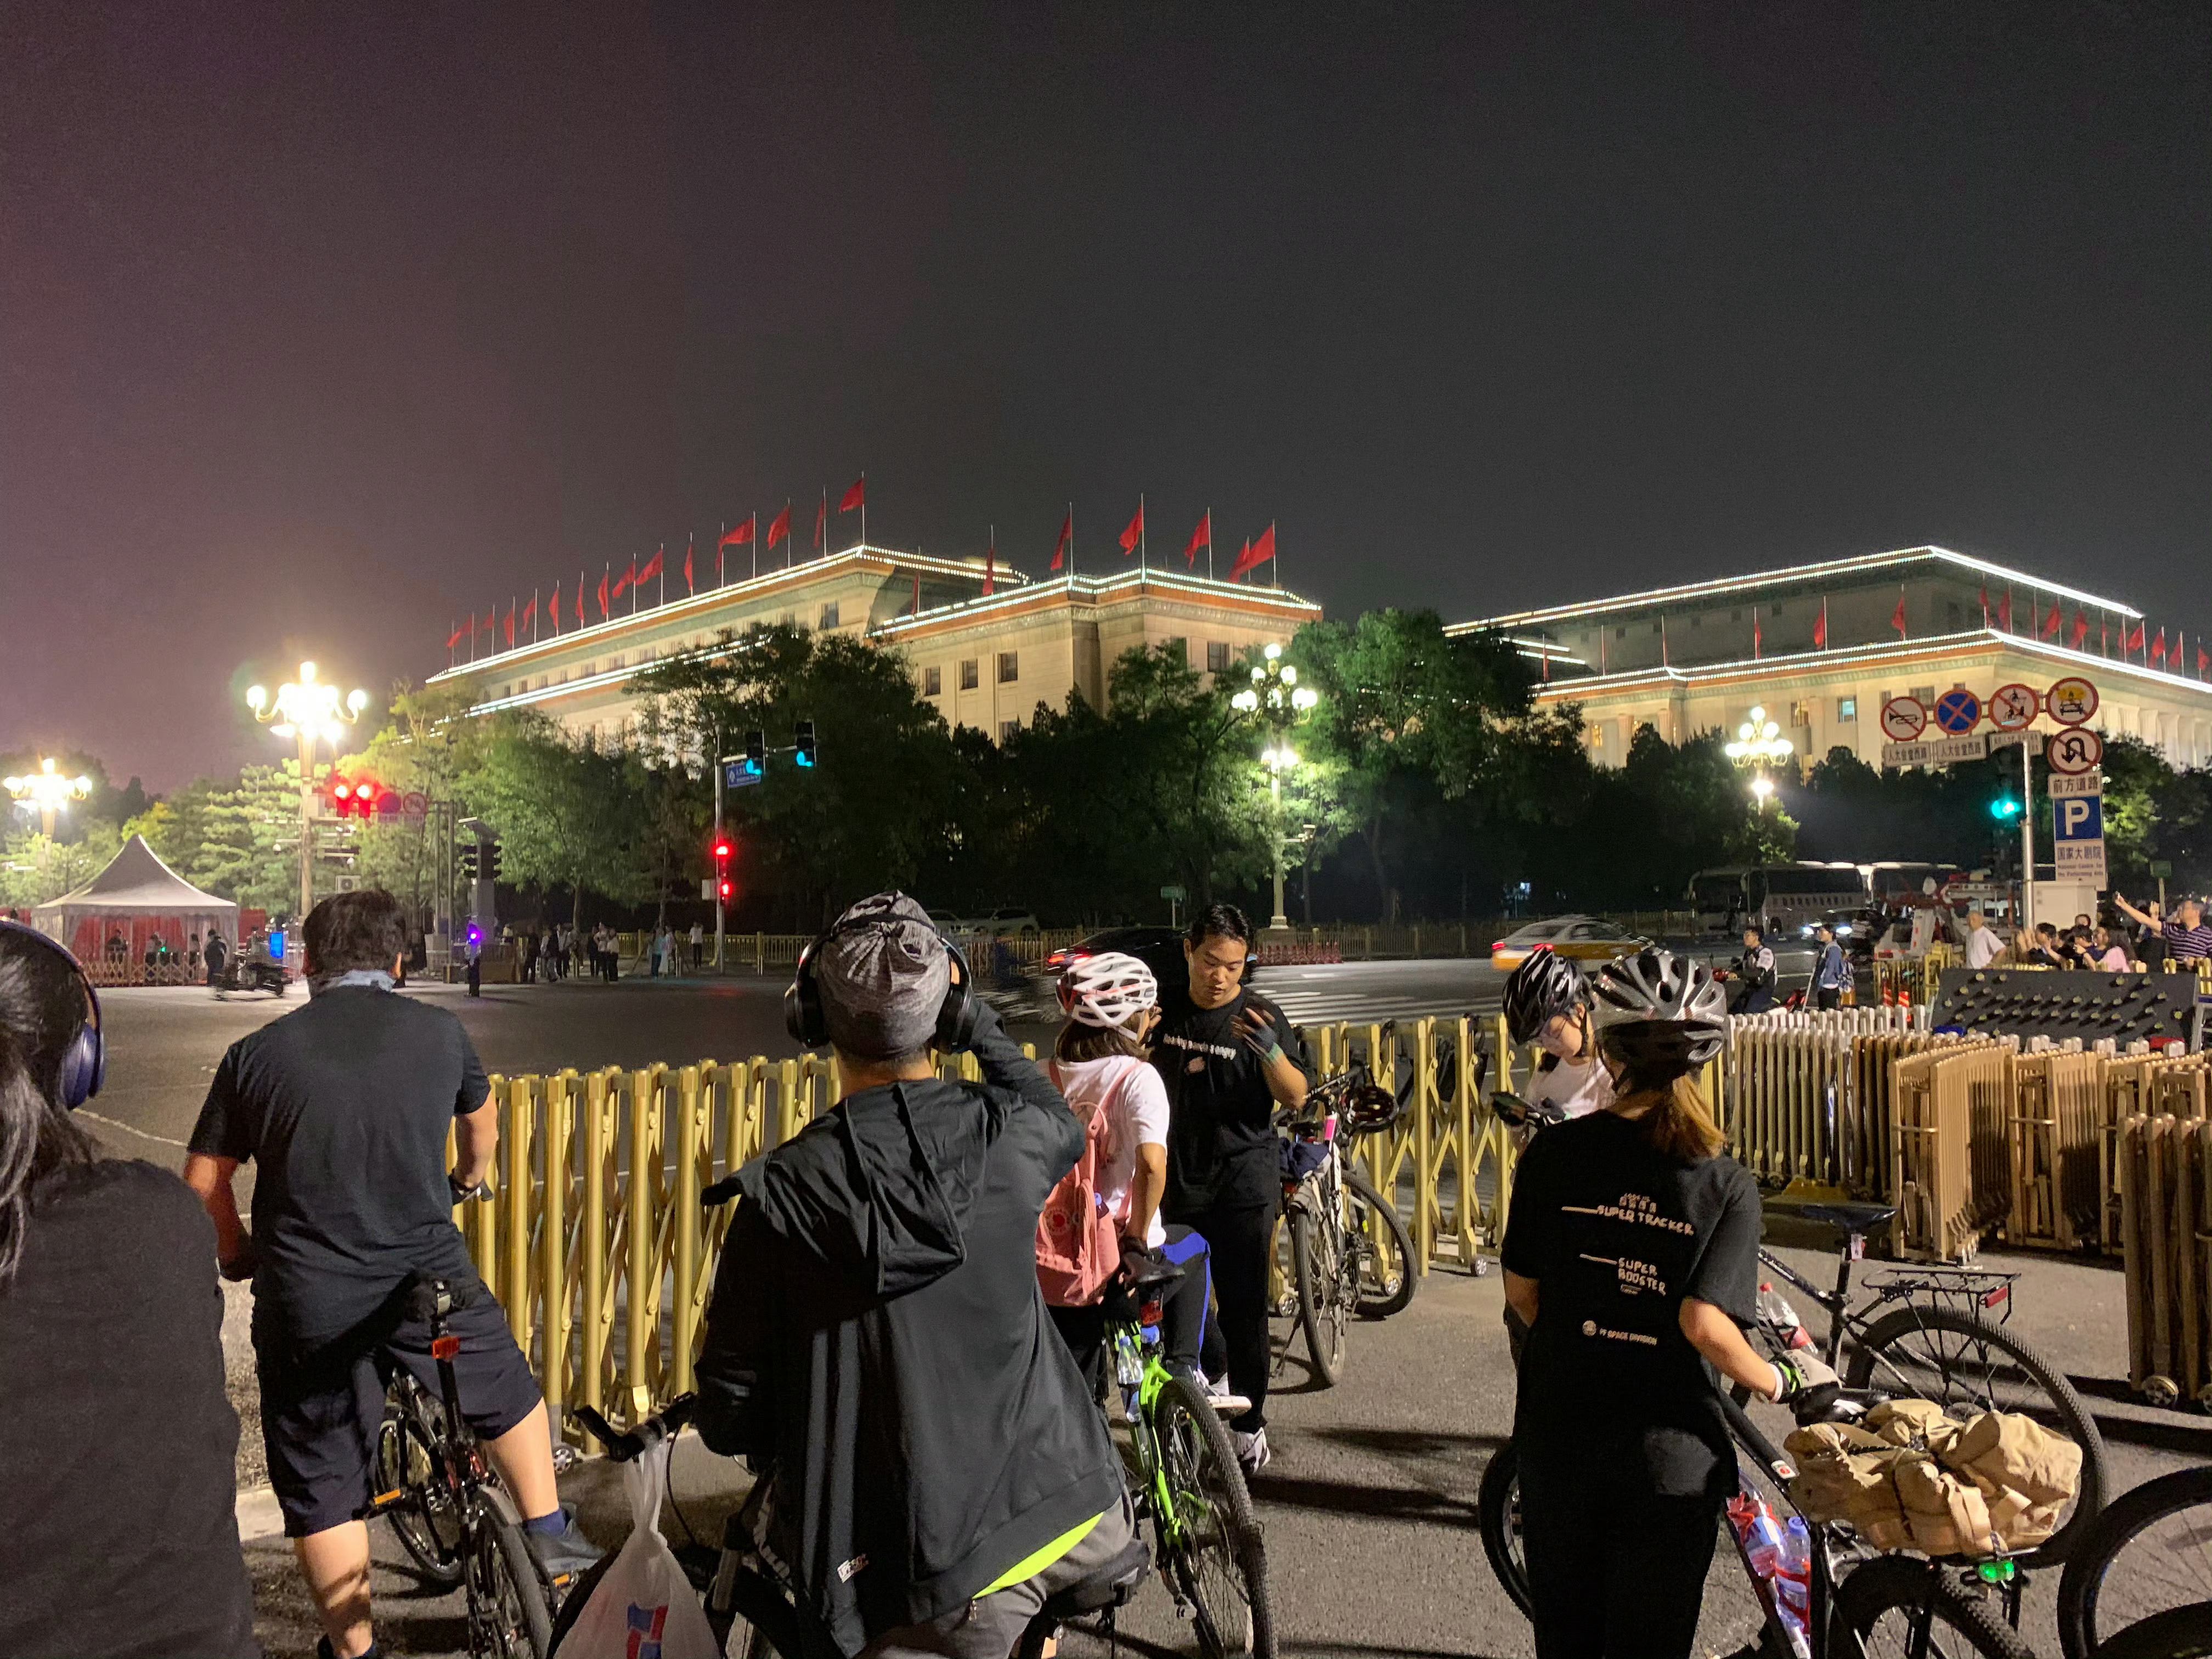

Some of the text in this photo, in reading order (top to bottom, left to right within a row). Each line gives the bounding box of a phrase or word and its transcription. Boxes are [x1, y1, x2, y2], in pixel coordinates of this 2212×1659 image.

[2052, 776, 2099, 794] 前方道路
[2064, 800, 2089, 836] P
[2057, 846, 2102, 860] 国家大剧院
[1597, 1205, 1694, 1236] SUPER TRACKER
[1618, 1257, 1657, 1277] SUPER
[1618, 1268, 1666, 1296] BOOSTER
